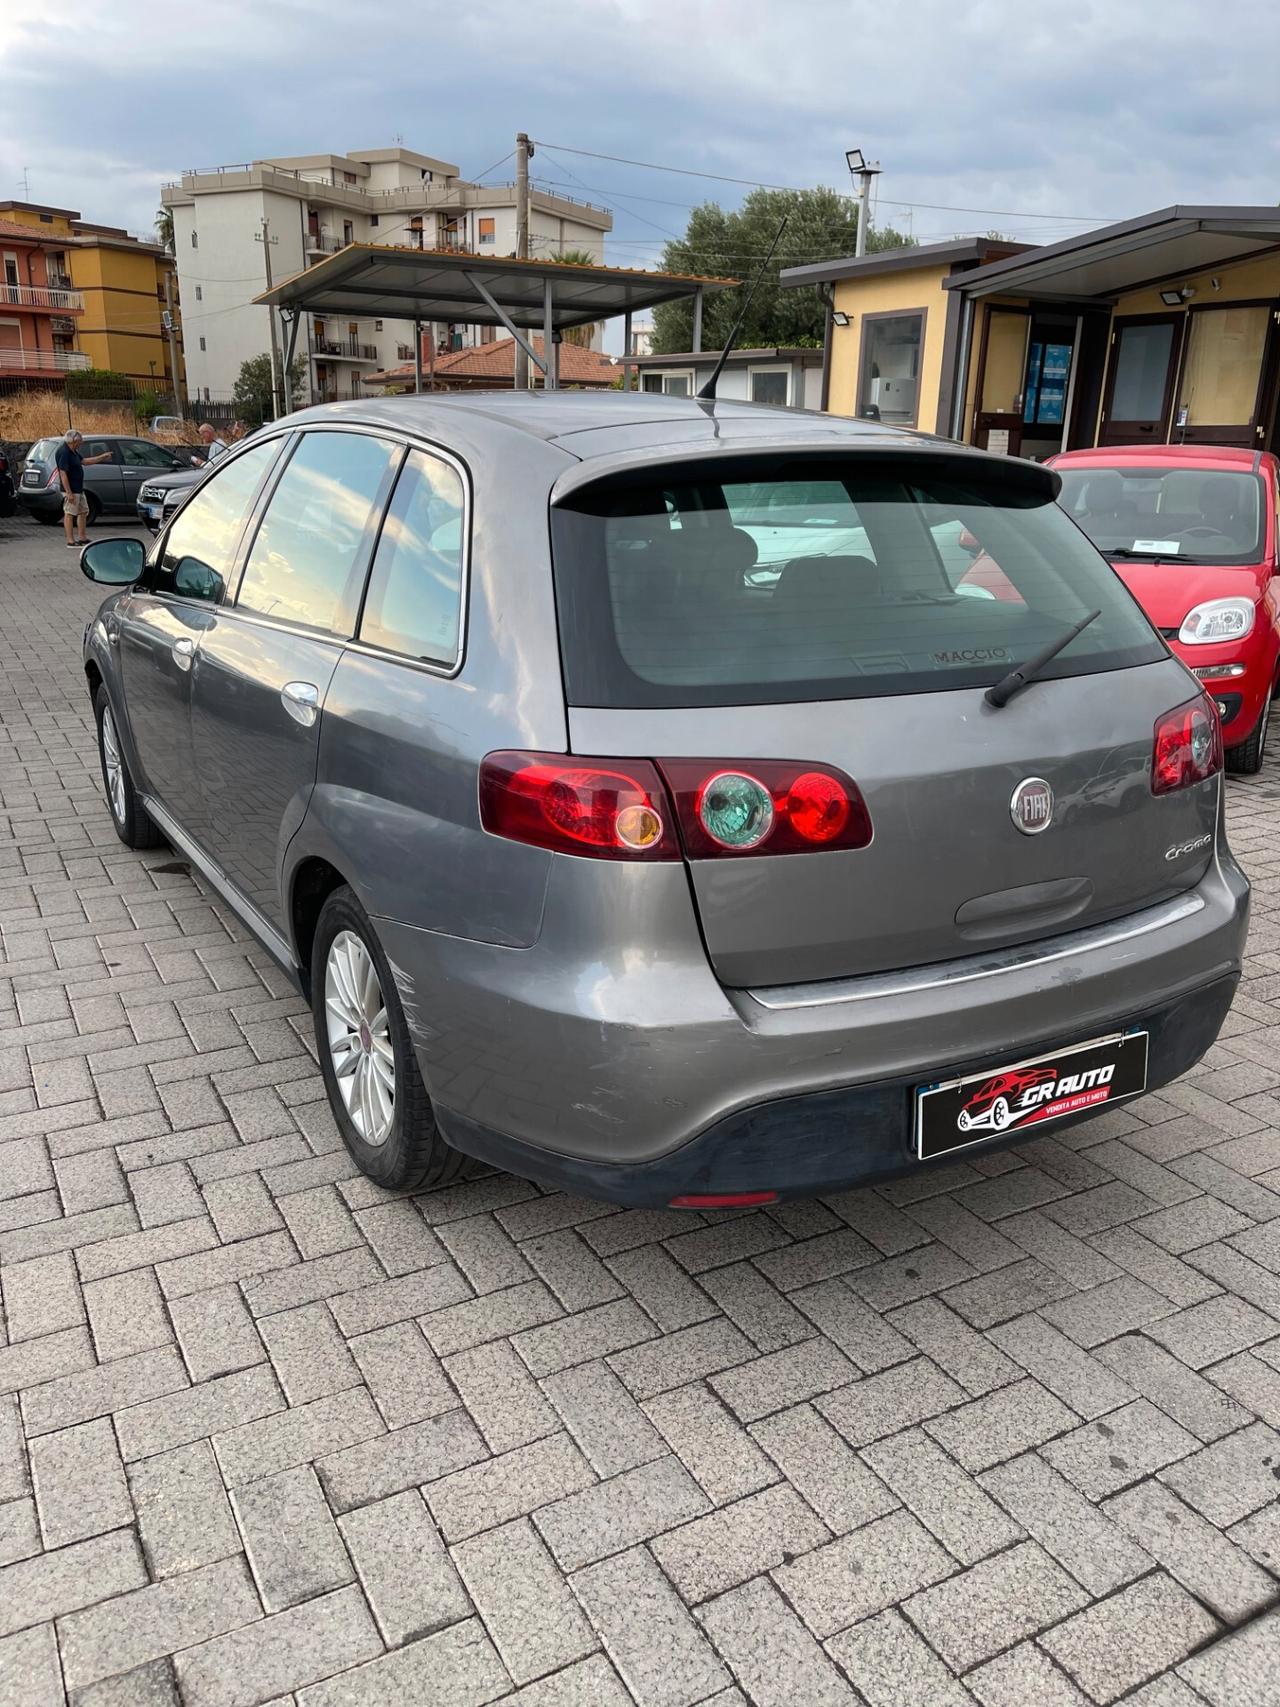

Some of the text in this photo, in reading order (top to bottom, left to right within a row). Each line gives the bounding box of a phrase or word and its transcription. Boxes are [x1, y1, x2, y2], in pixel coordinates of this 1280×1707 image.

[934, 648, 1006, 662] MACCIO
[1023, 793, 1047, 821] FIAT
[1165, 834, 1212, 861] Croma
[1021, 1064, 1115, 1107] GR AUTO
[1046, 1102, 1070, 1114] VENDITA
[1071, 1097, 1086, 1107] AUTO
[1091, 1090, 1108, 1100] MOTO
